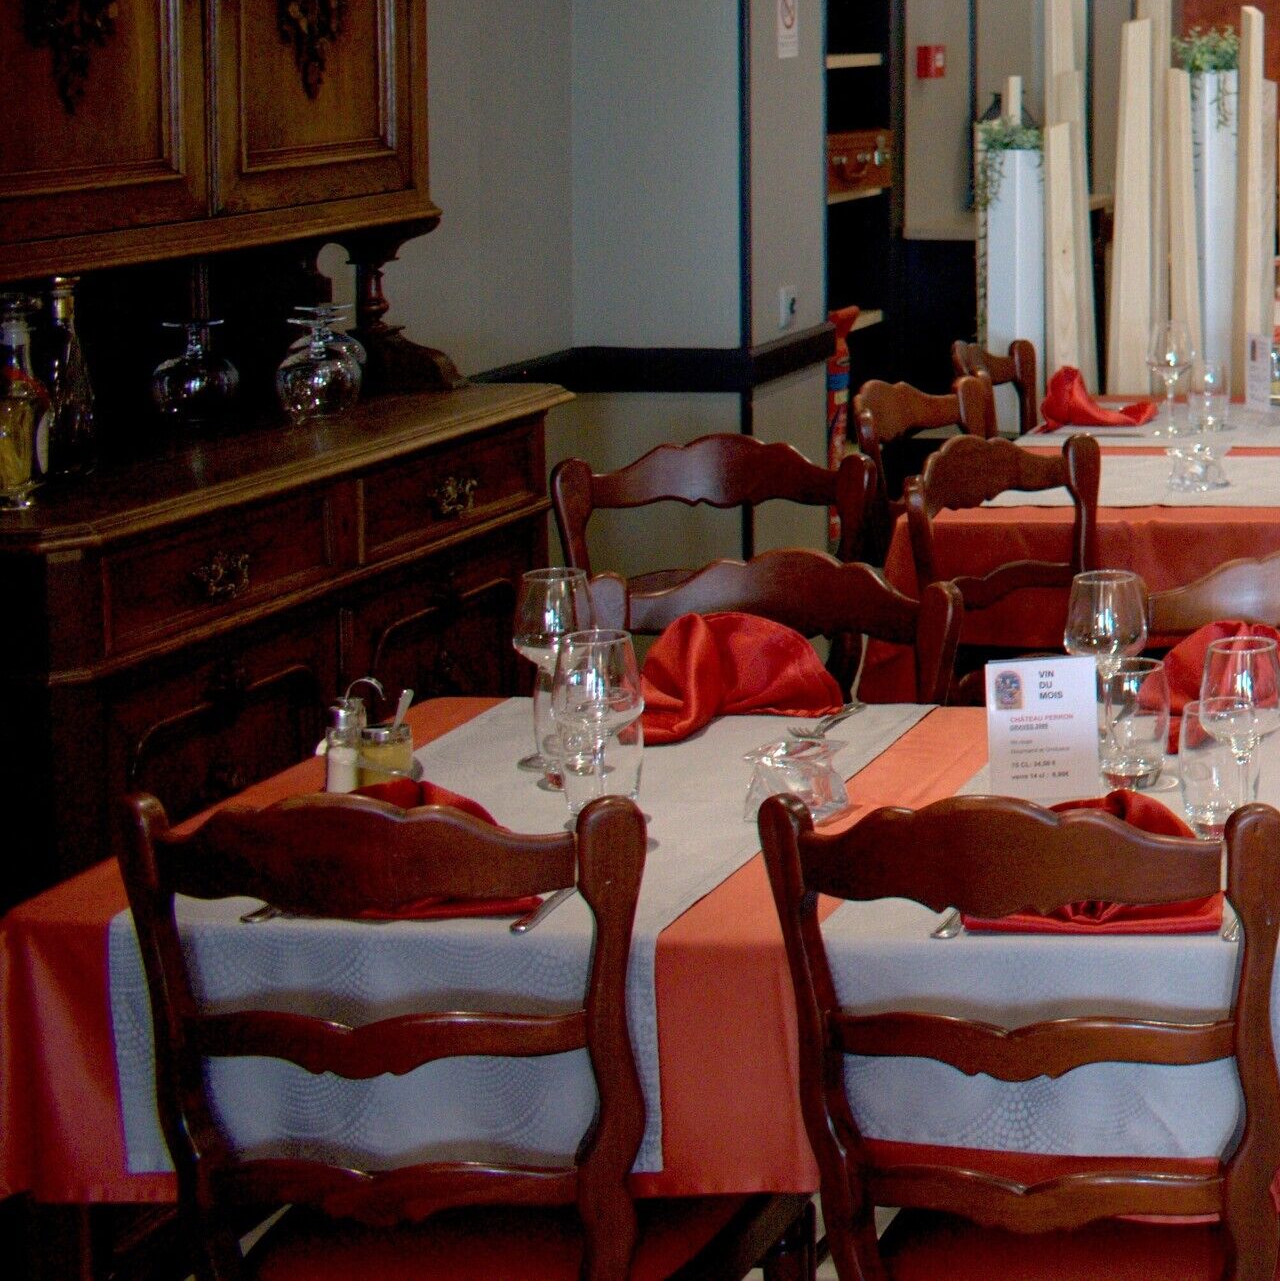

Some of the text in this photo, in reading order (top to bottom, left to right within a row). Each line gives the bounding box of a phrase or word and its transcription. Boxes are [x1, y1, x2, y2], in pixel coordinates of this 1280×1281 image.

[1038, 670, 1054, 678] VIN
[1039, 681, 1053, 689] DU
[1039, 691, 1063, 700] MOIS
